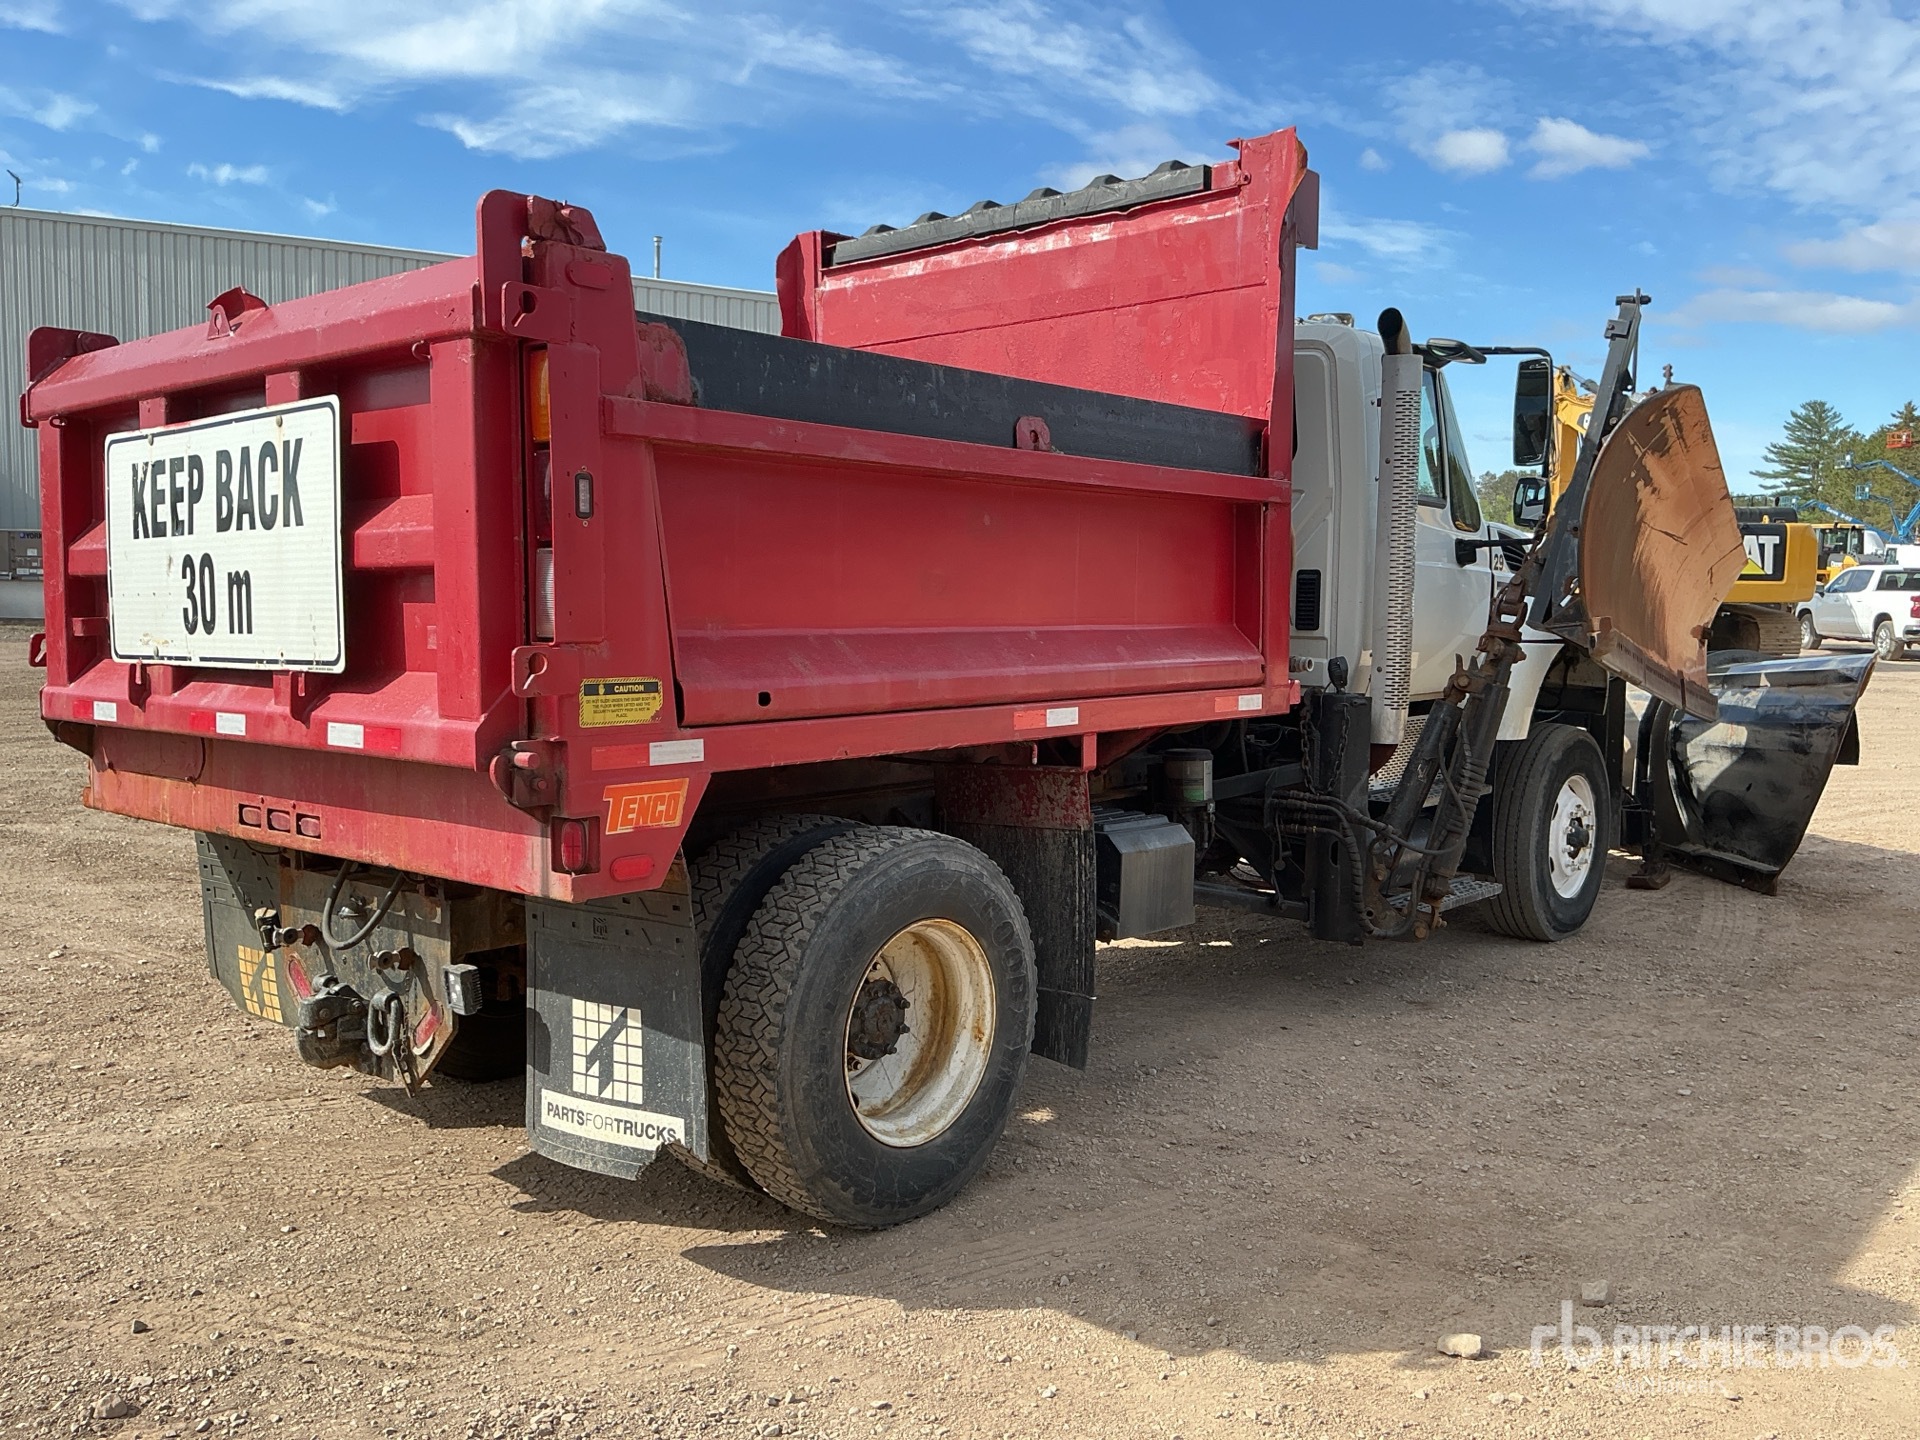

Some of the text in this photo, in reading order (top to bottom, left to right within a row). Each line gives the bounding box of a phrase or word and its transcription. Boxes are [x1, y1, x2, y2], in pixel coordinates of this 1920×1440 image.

[131, 437, 304, 540] KEEP BACK
[1493, 553, 1504, 571] 29
[1743, 535, 1780, 575] AT
[181, 552, 253, 636] 30 m
[615, 685, 644, 693] CAUTION
[603, 778, 687, 835] TENCO
[547, 1101, 677, 1144] PARTSFORTRUCKS
